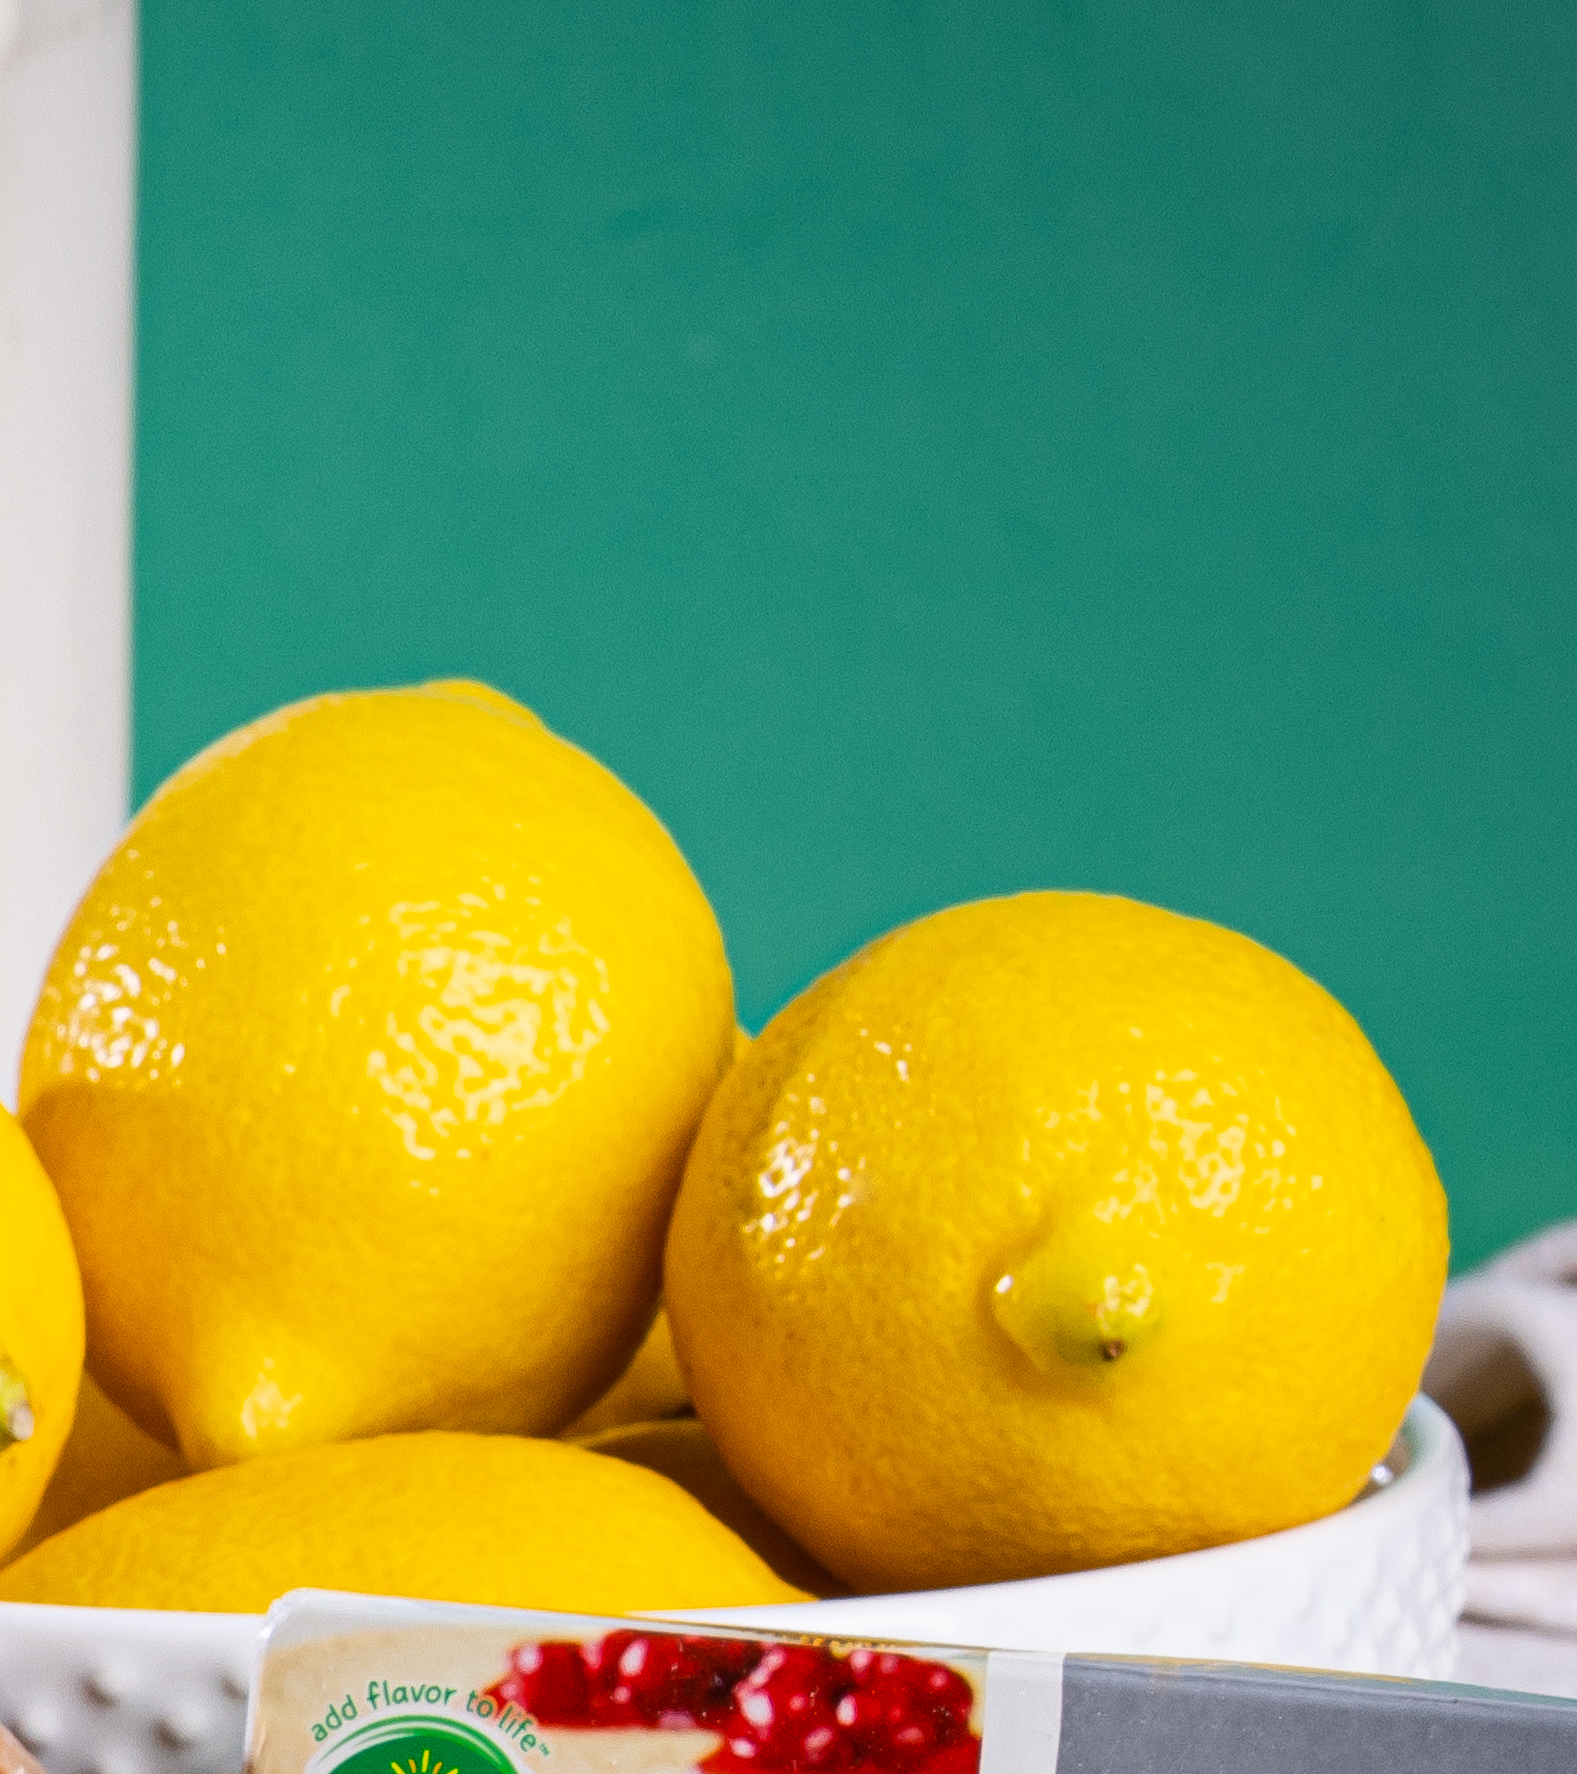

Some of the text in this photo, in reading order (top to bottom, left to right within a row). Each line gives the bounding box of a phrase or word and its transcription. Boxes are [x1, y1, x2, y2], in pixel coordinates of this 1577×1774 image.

[311, 1693, 359, 1742] add
[366, 1679, 458, 1710] flavor
[466, 1688, 495, 1719] to
